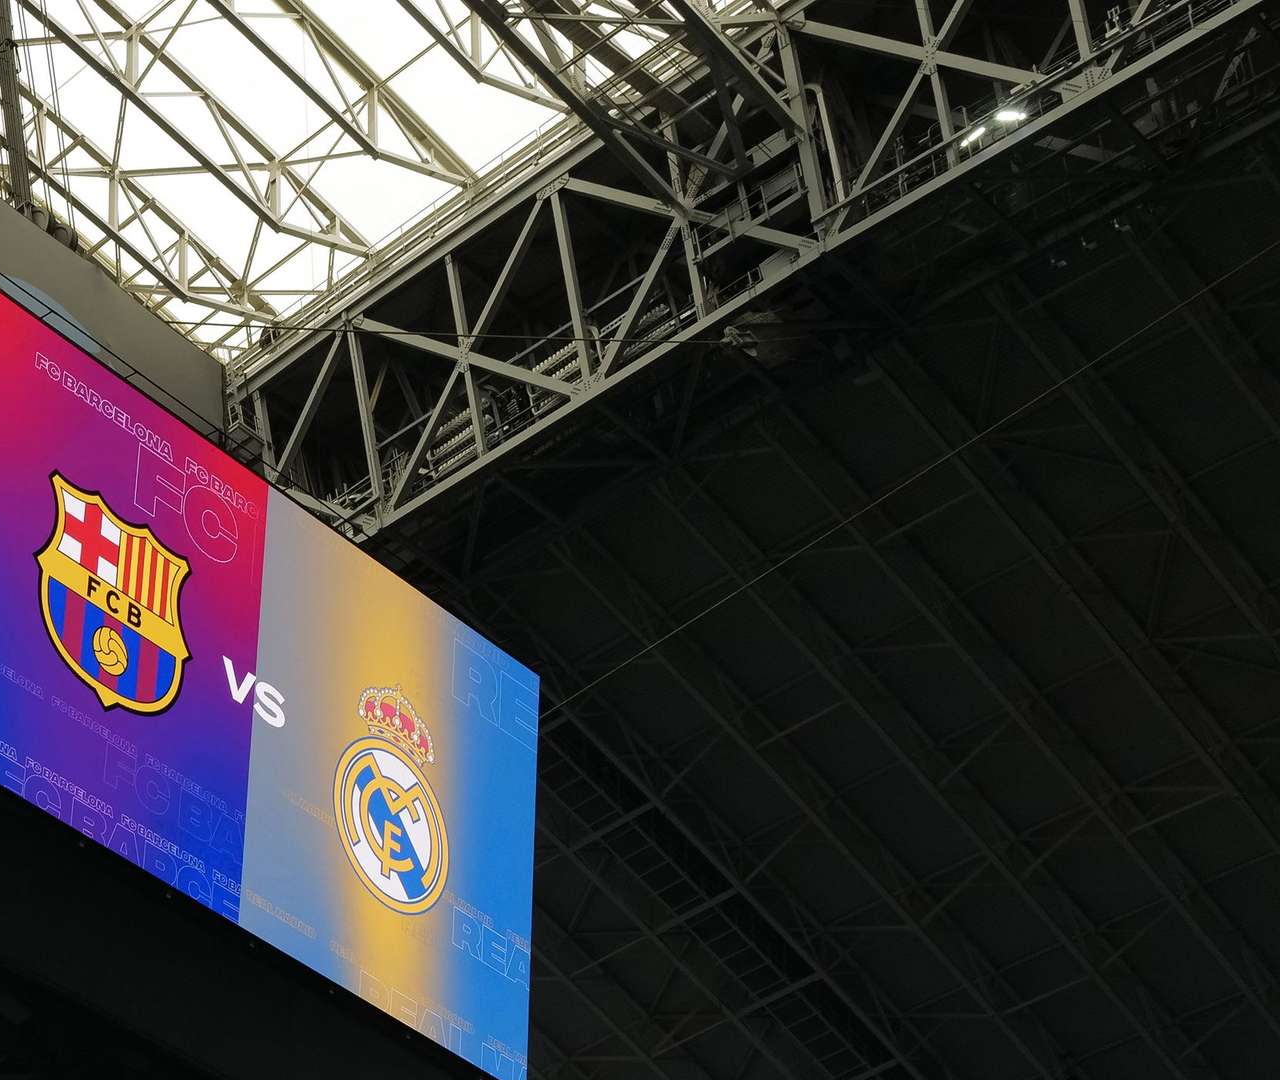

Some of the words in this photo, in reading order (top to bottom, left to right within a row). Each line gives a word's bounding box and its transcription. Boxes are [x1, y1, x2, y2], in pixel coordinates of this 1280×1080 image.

[33, 352, 60, 383] FC
[61, 371, 175, 462] BARCELONA
[87, 570, 142, 628] FCB
[222, 655, 285, 729] VS
